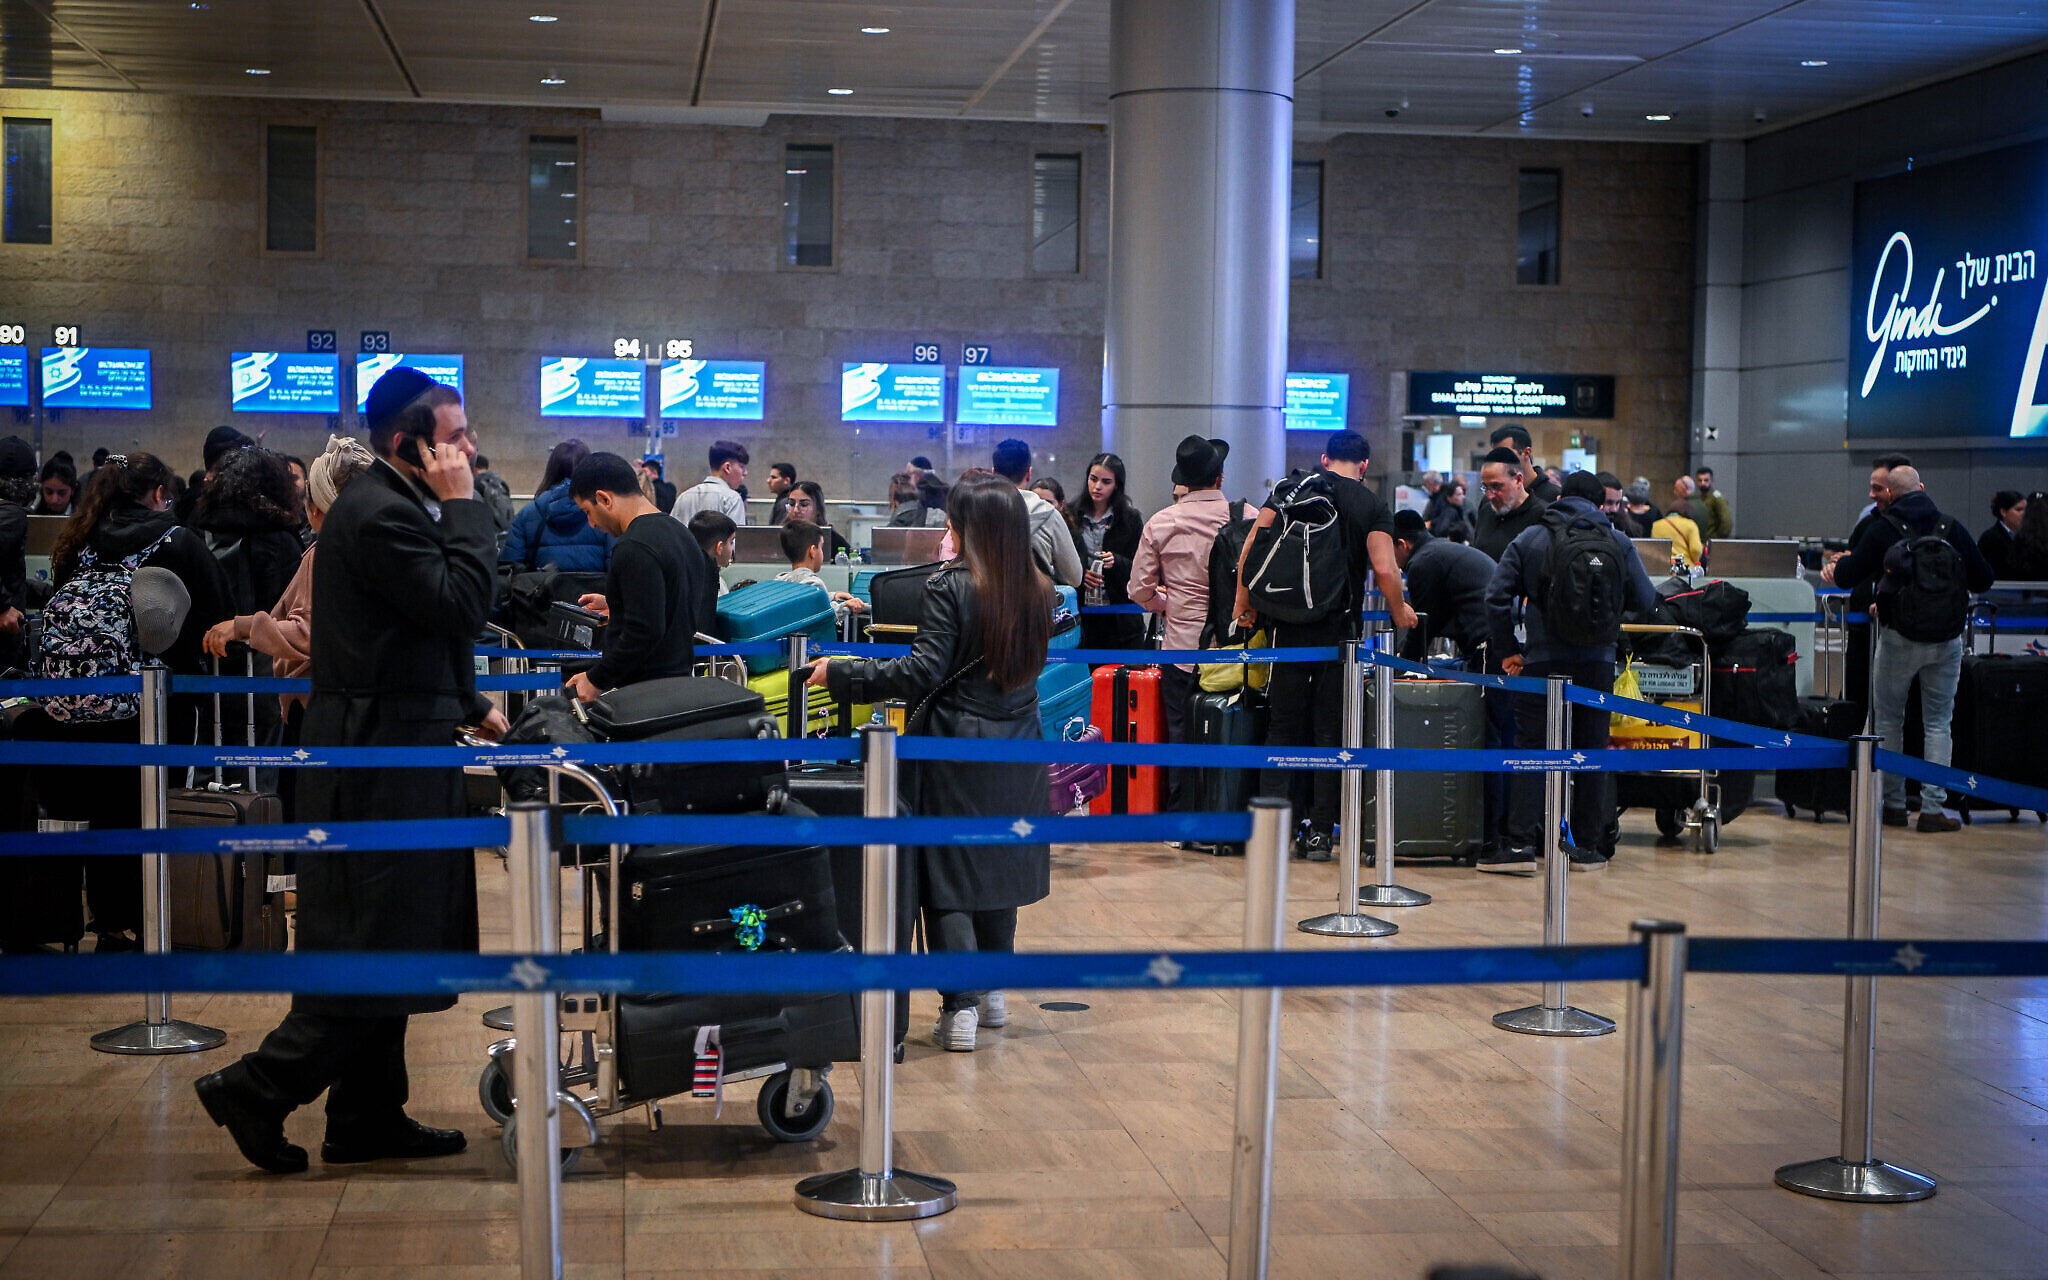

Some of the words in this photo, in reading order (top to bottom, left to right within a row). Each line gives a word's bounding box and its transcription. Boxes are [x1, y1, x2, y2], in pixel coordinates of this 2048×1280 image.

[1956, 252, 1990, 299] שלך
[1994, 250, 2035, 284] הבית
[0, 325, 25, 344] 90
[55, 326, 77, 345] 91
[310, 333, 334, 349] 92
[363, 334, 387, 350] 93
[614, 338, 640, 357] 94
[666, 339, 692, 358] 95
[915, 345, 938, 361] 96
[965, 347, 988, 363] 97
[1940, 345, 1967, 369] גינדי
[1514, 394, 1566, 406] COUNTERS
